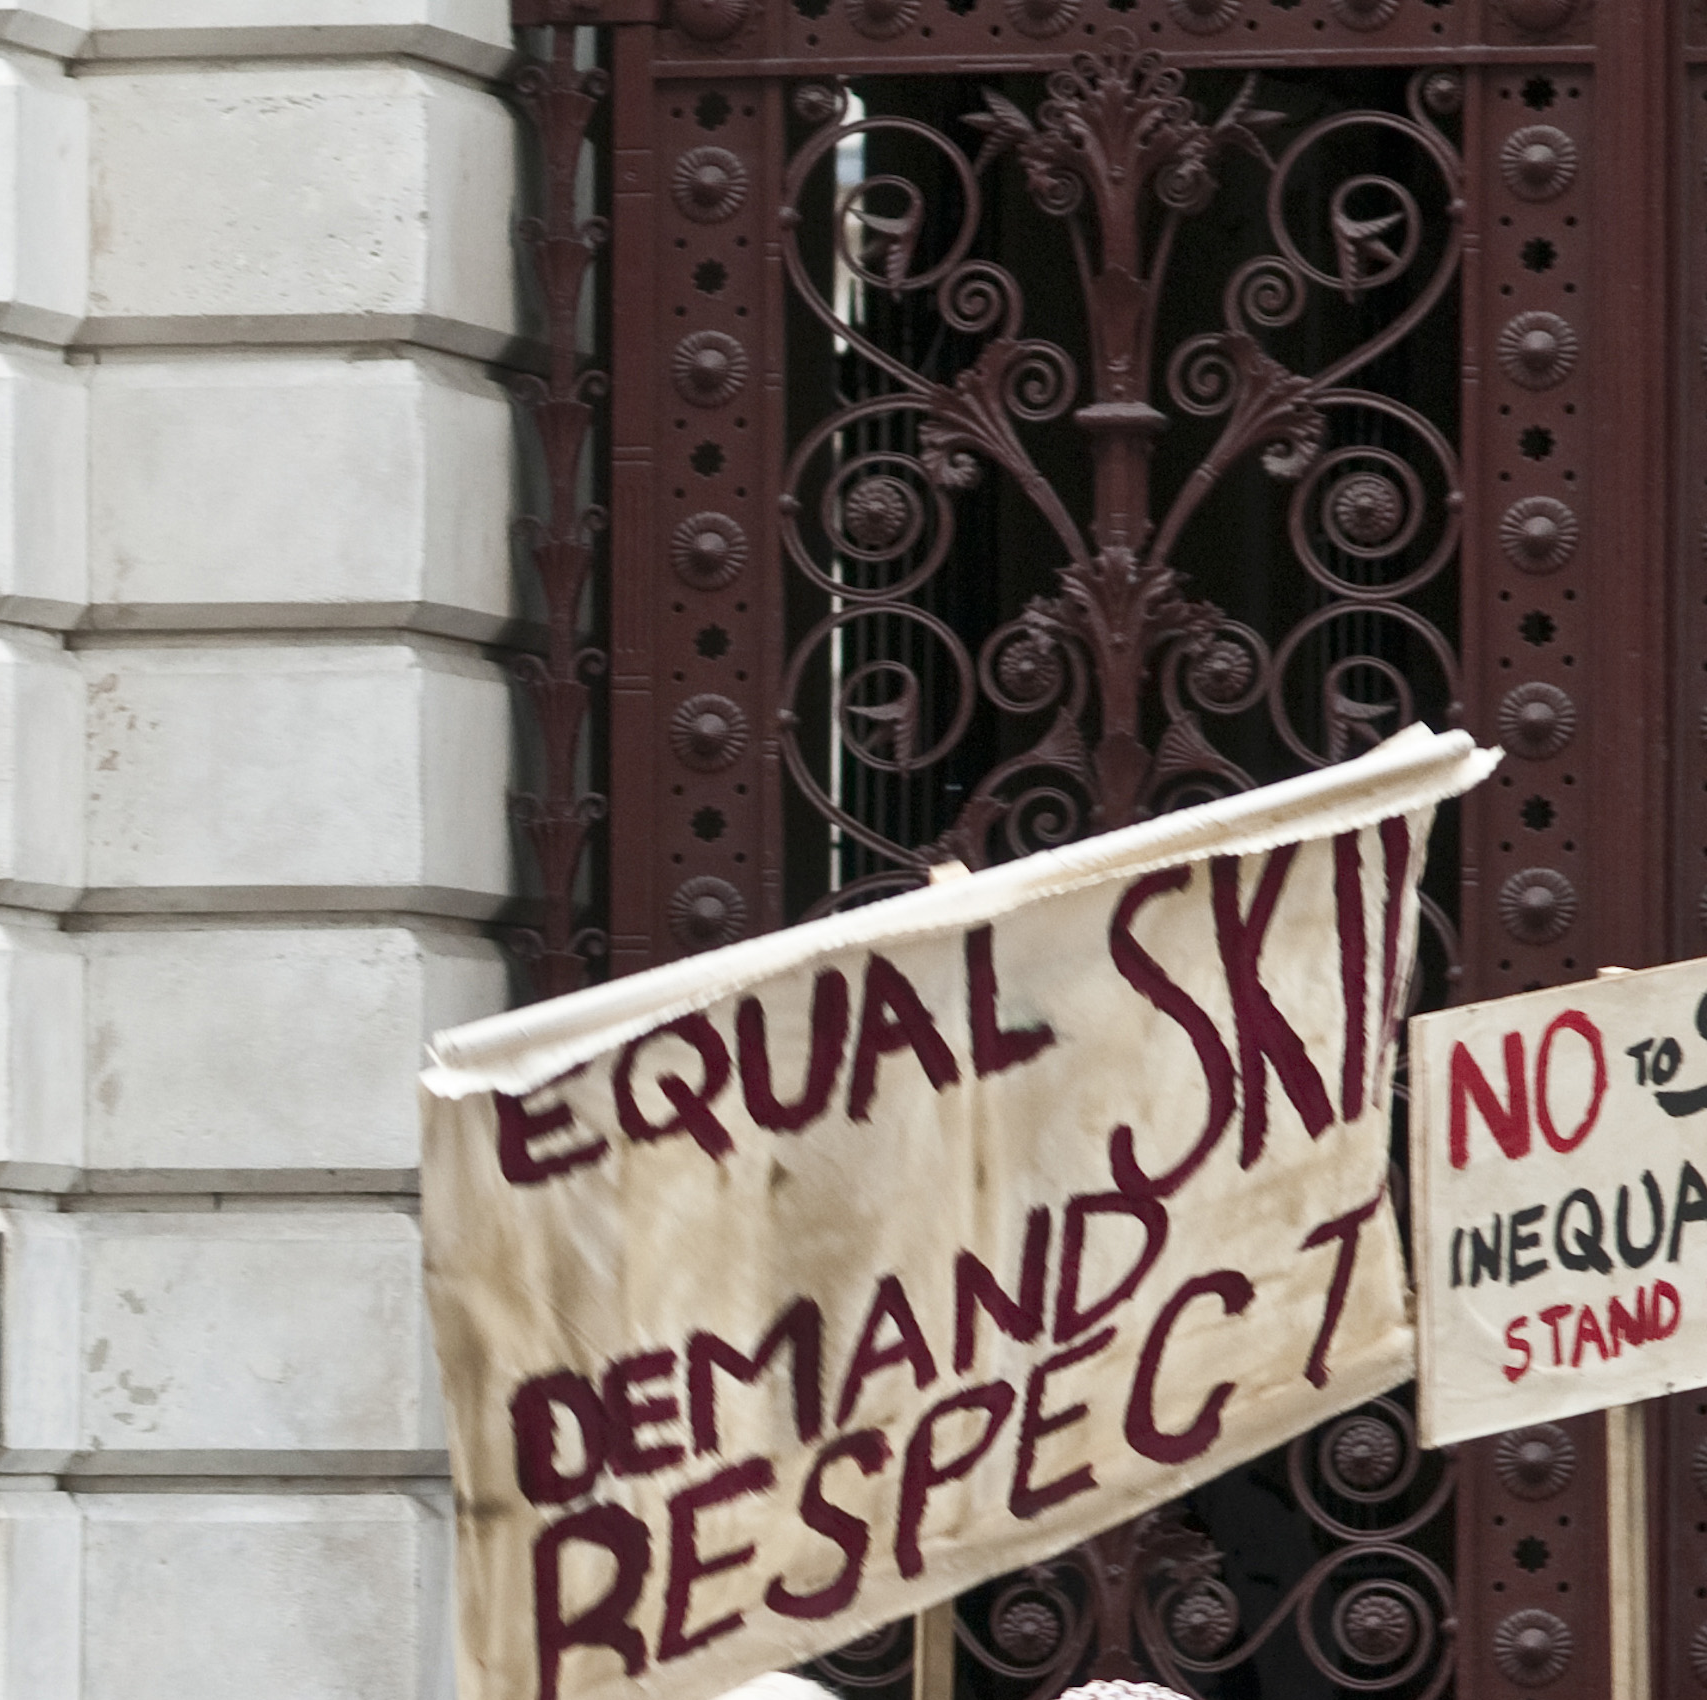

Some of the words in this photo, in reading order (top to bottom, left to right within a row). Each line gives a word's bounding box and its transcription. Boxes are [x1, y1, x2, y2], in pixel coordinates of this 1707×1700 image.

[495, 920, 1056, 1187] EQUAL
[1448, 1008, 1609, 1171] NO
[1450, 1159, 1707, 1288] INEQUA
[508, 1190, 1169, 1506] DEMAND
[1501, 1279, 1682, 1384] STAND
